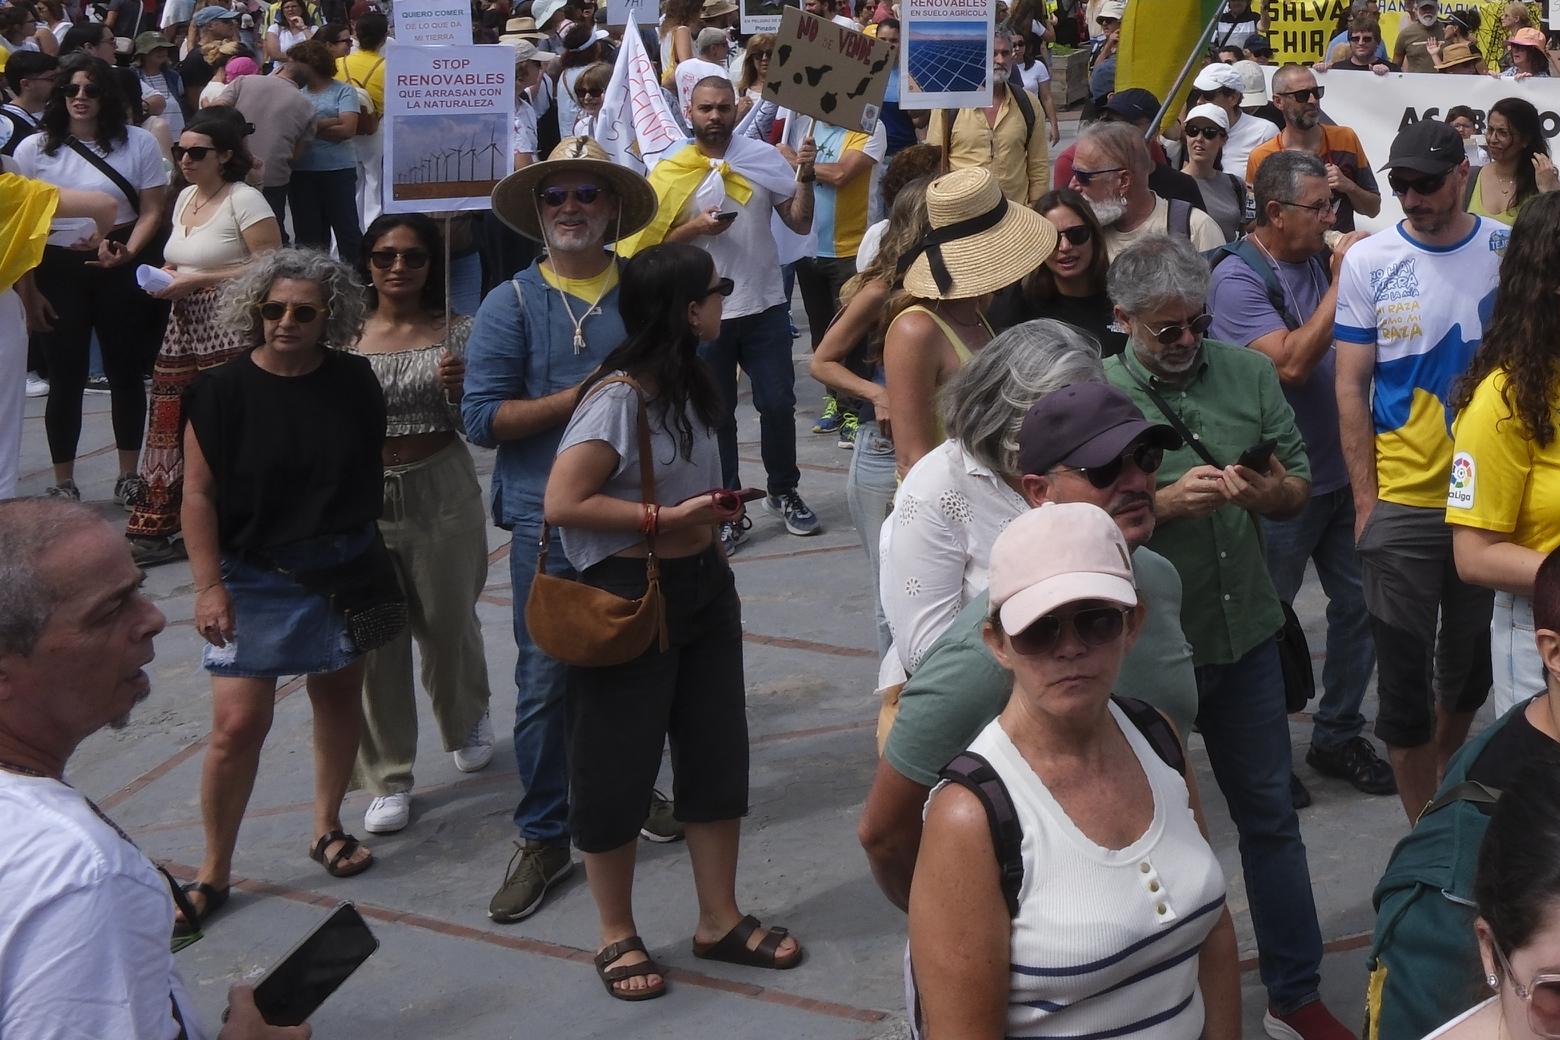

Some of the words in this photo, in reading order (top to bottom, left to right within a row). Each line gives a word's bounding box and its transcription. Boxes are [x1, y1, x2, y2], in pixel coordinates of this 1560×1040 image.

[401, 11, 432, 19] QUIERO
[434, 9, 464, 17] COMER
[419, 22, 429, 30] LO
[431, 21, 448, 29] QUE
[426, 33, 454, 41] TIERRA
[796, 16, 819, 42] NO
[839, 29, 875, 65] VENDE
[1268, 29, 1335, 58] CHIR
[432, 59, 470, 70] STOP
[397, 73, 505, 86] RENOVABLES
[399, 90, 421, 99] QUE
[424, 88, 477, 98] ARRASAN
[479, 88, 502, 97] CON
[406, 100, 420, 109] LA
[423, 99, 495, 109] NATURALEZA
[1448, 489, 1471, 502] aLiga
